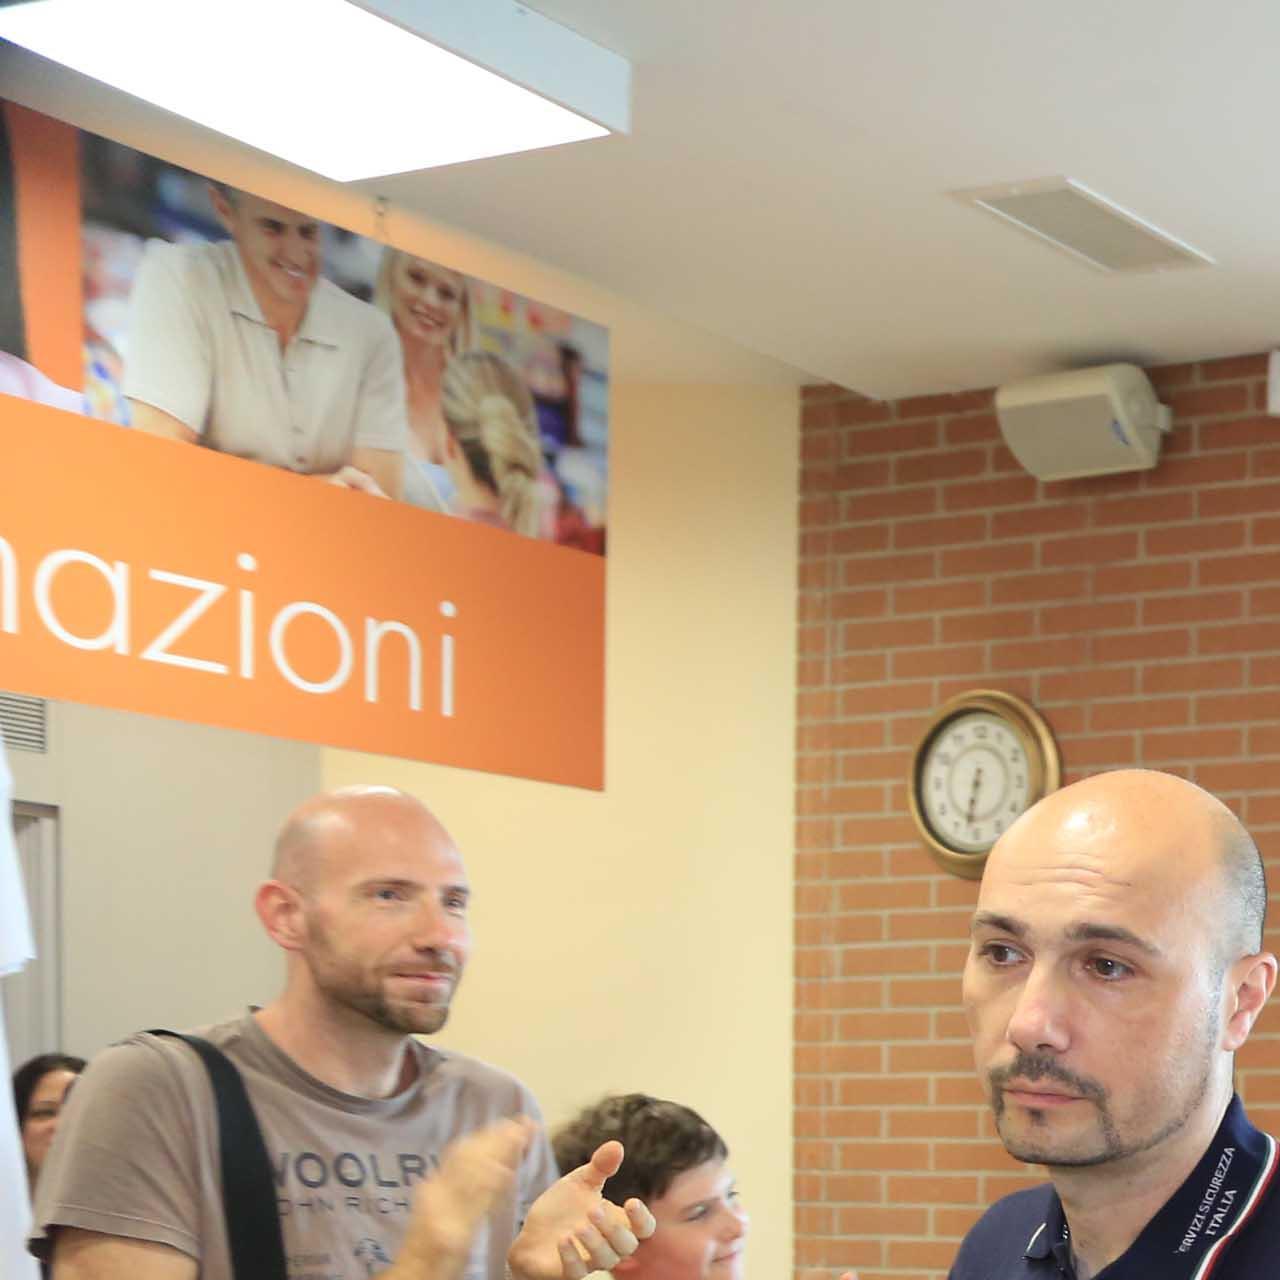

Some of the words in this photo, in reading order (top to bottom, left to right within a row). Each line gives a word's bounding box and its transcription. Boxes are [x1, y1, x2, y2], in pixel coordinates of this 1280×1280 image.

[0, 535, 457, 718] azioni
[275, 1151, 440, 1187] OOLR
[1173, 1213, 1206, 1255] ERVIZI
[1199, 1147, 1235, 1213] SICUREZZA
[1205, 1190, 1237, 1235] ITALIA
